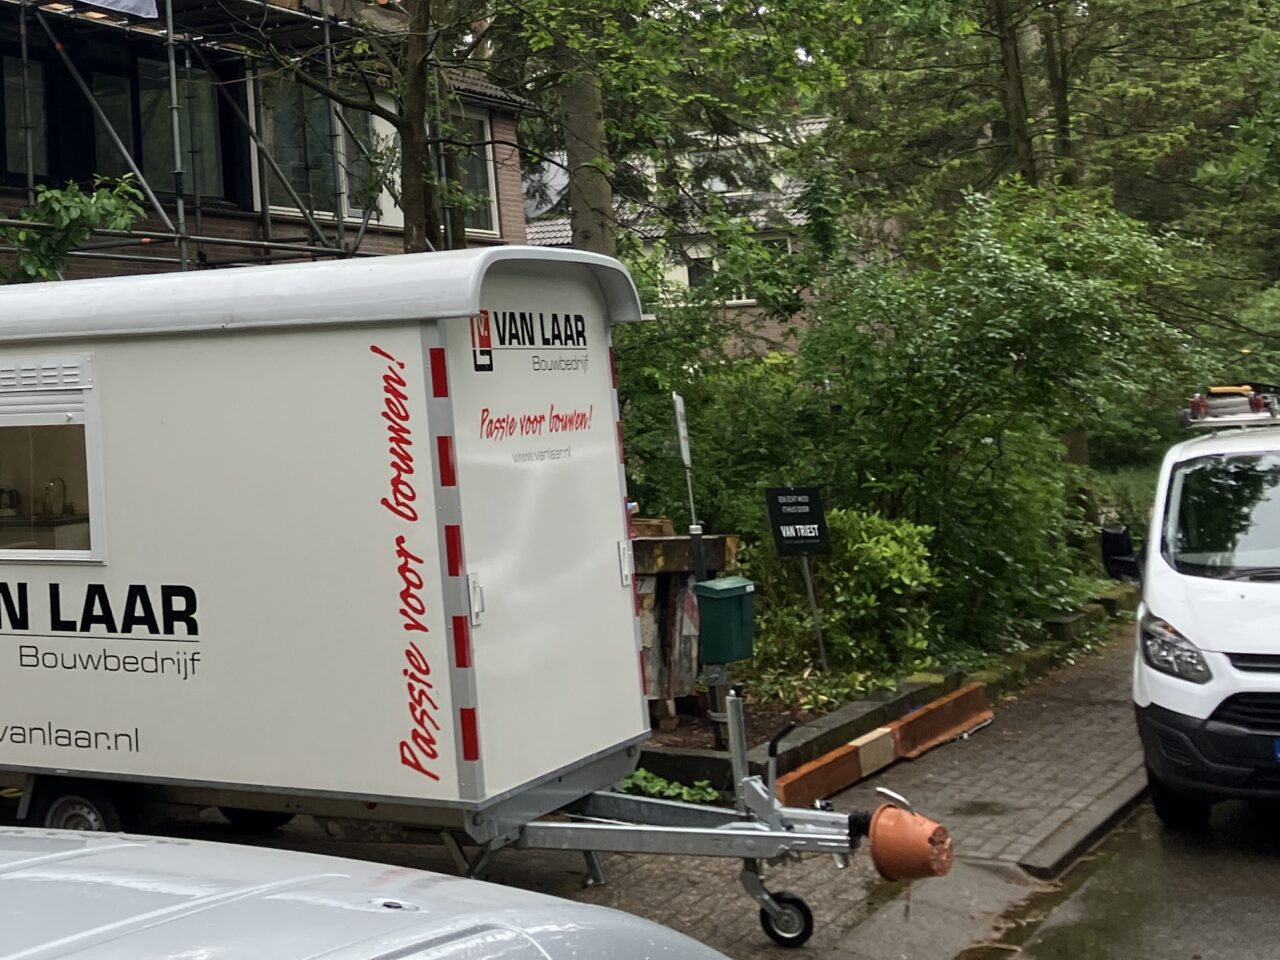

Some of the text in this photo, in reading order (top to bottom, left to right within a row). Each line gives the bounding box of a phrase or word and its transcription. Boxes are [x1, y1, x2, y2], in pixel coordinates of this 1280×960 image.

[493, 311, 587, 347] VAN LAAR
[532, 355, 589, 373] Bouwbedrijf
[479, 403, 593, 441] Passie voor bouwen!
[511, 446, 572, 464] www.vanlaar.nl
[780, 525, 796, 537] VAN
[370, 345, 441, 781] Passie voor bouwen!
[48, 582, 199, 636] LAAR
[19, 645, 201, 680] Bouwbedrijf
